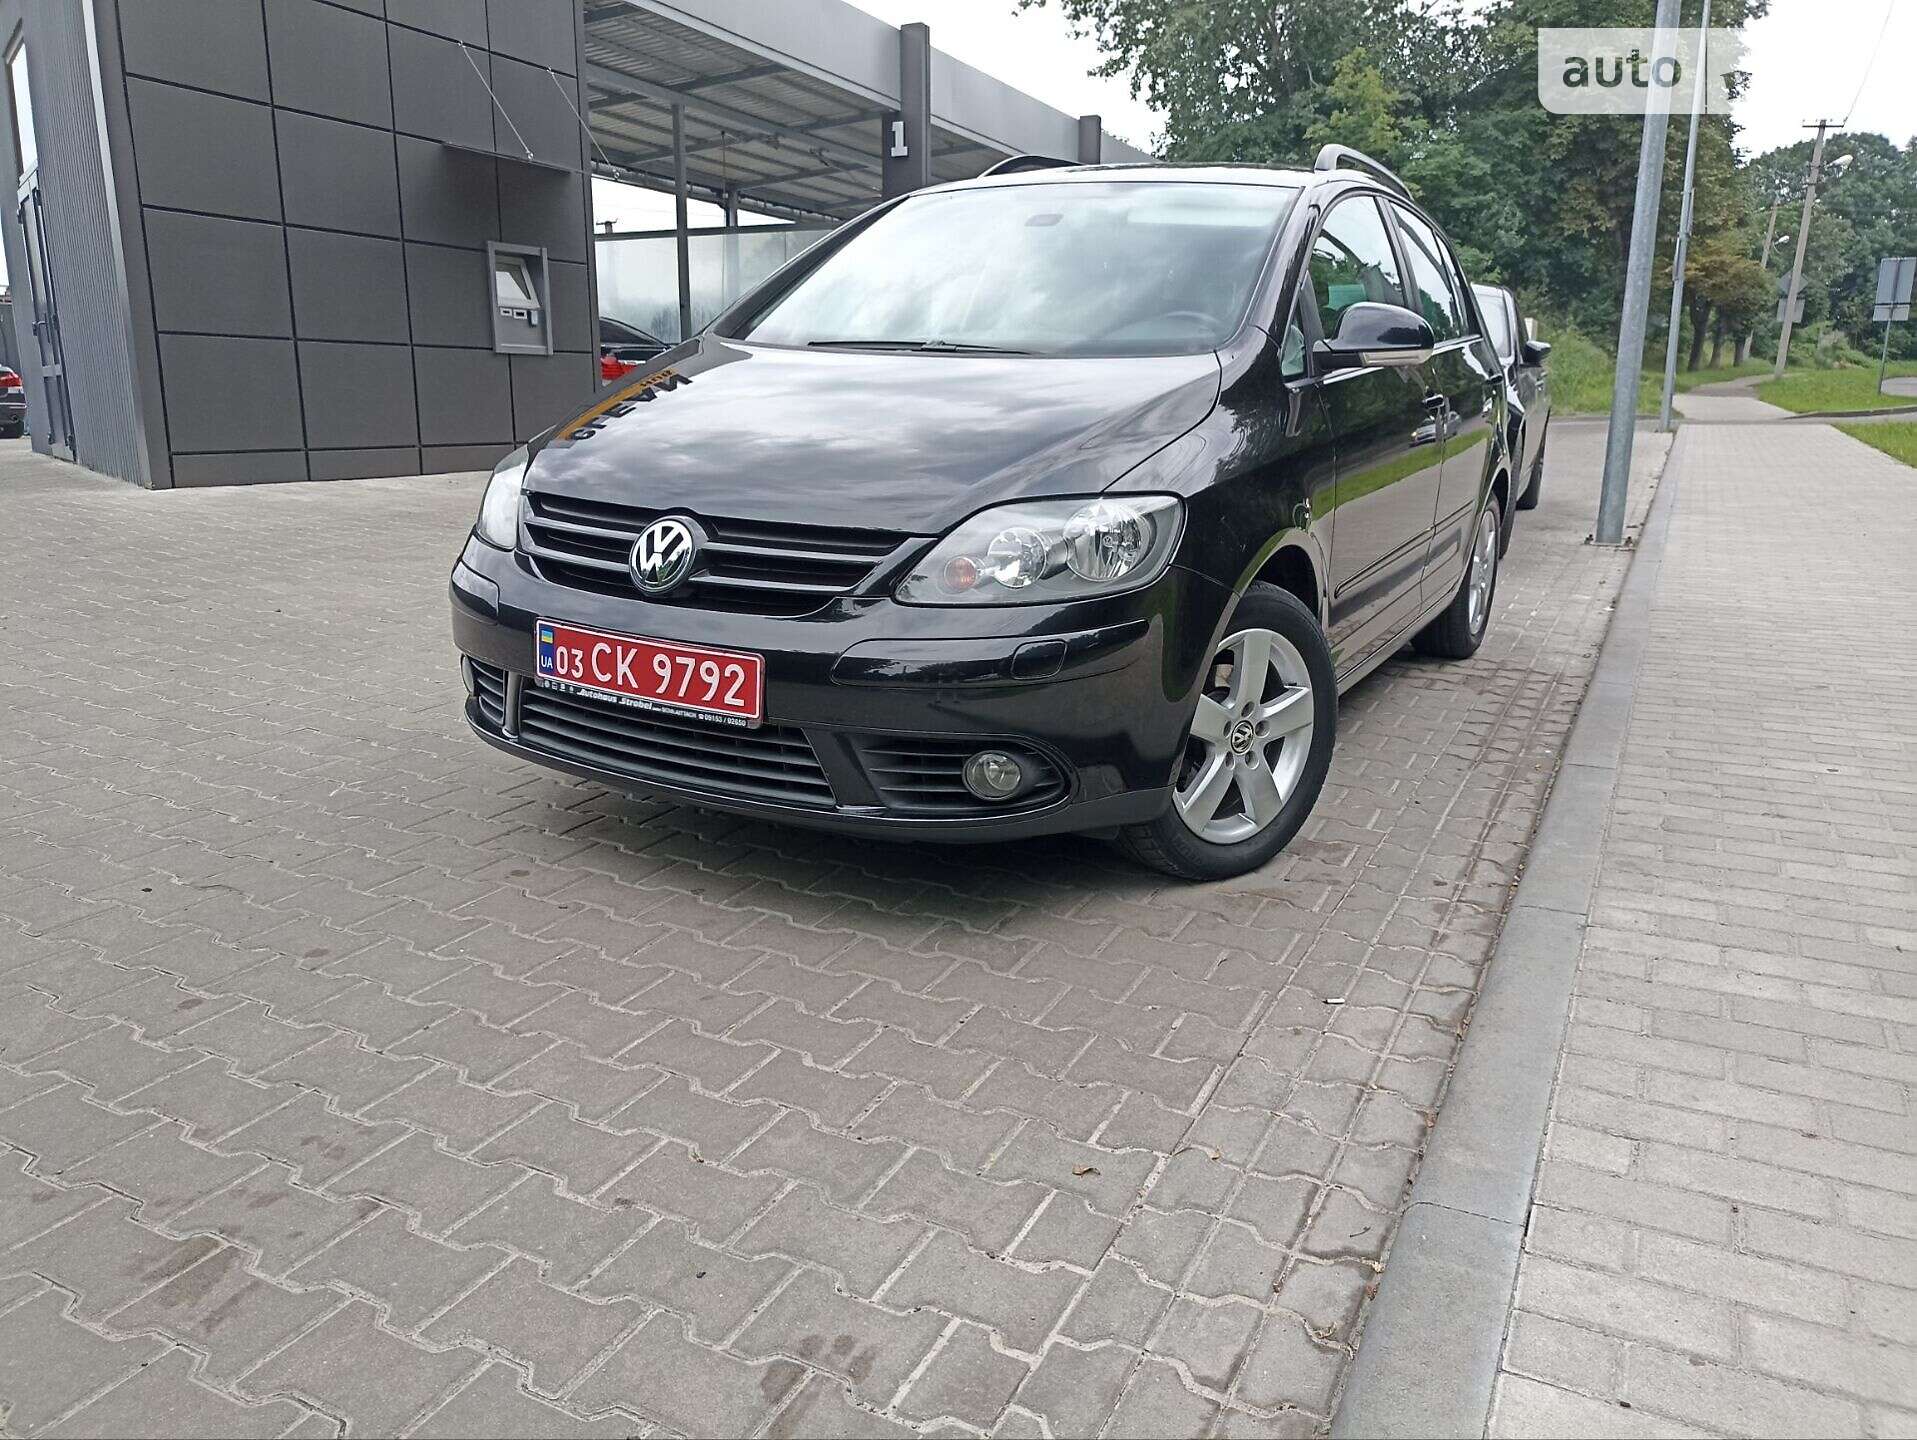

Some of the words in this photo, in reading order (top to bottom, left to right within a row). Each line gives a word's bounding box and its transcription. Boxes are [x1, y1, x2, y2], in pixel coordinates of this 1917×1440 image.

[890, 121, 908, 157] 1
[540, 654, 553, 670] UA
[556, 645, 584, 679] 03
[591, 642, 638, 689] CK
[652, 653, 746, 707] 9792
[577, 688, 618, 703] Autohaus
